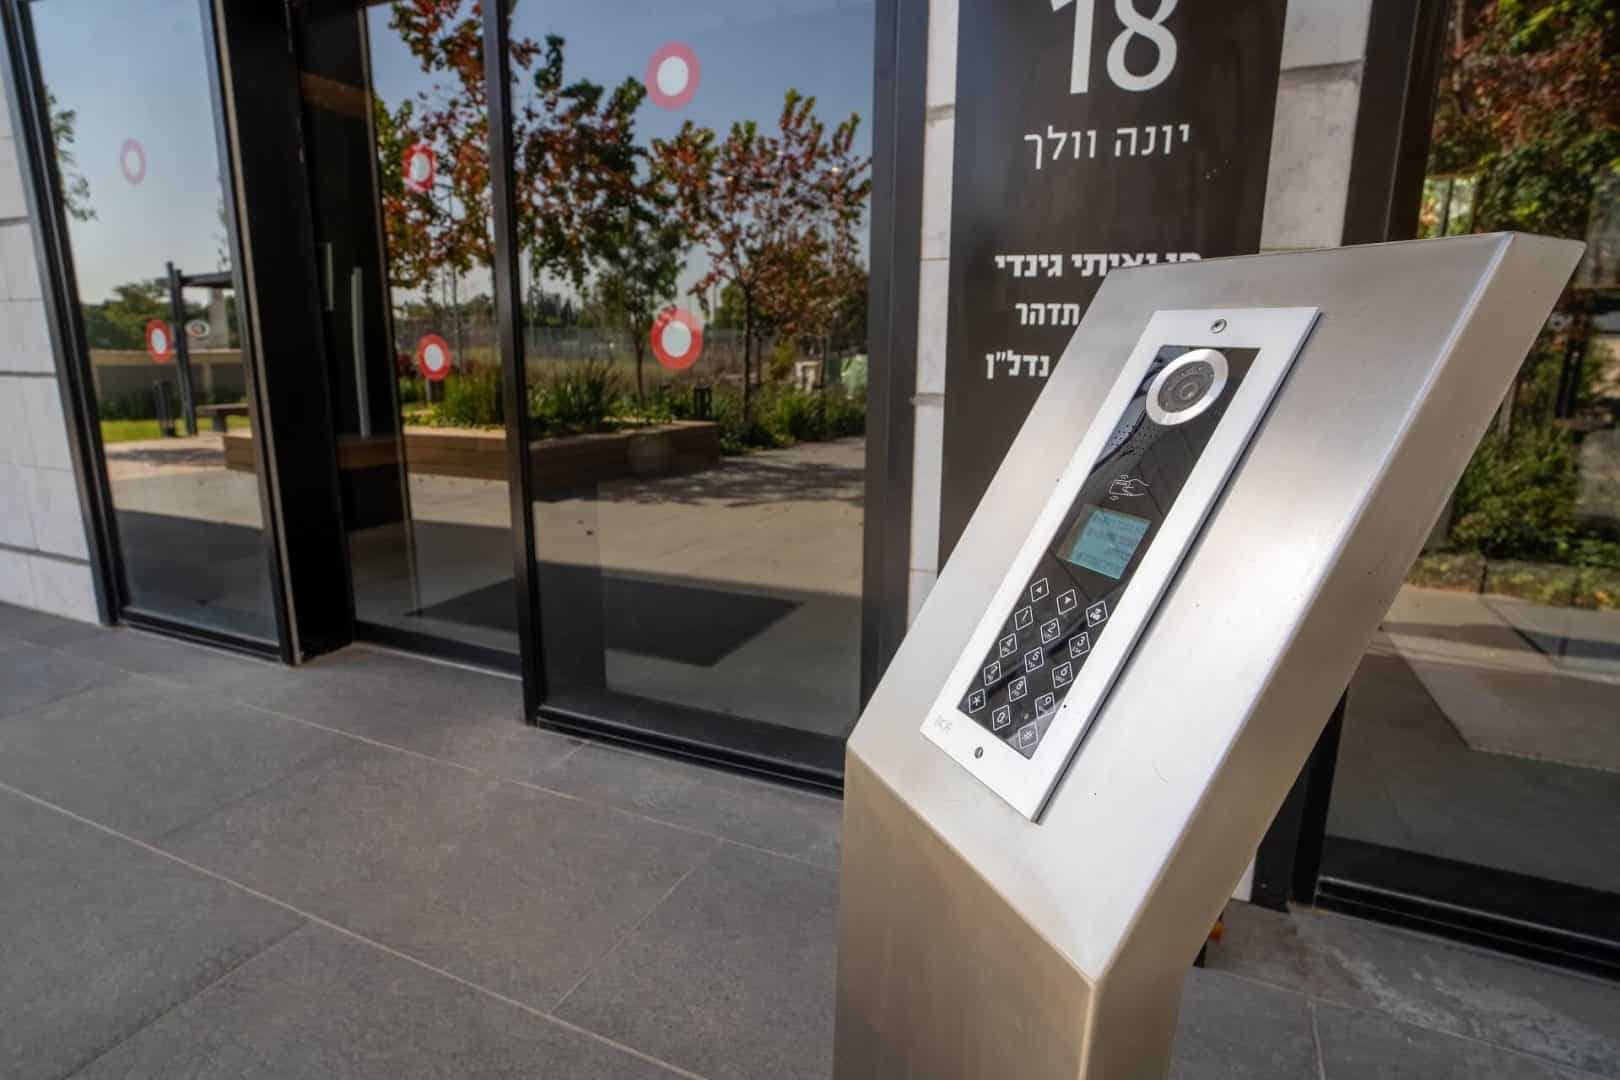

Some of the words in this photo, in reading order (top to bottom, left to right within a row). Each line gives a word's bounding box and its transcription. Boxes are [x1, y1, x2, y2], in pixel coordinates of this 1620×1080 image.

[1050, 0, 1178, 94] 18
[1023, 125, 1097, 171] וולך
[1114, 123, 1190, 158] יונה
[994, 254, 1063, 278] גינדי
[1015, 302, 1081, 326] תדהר
